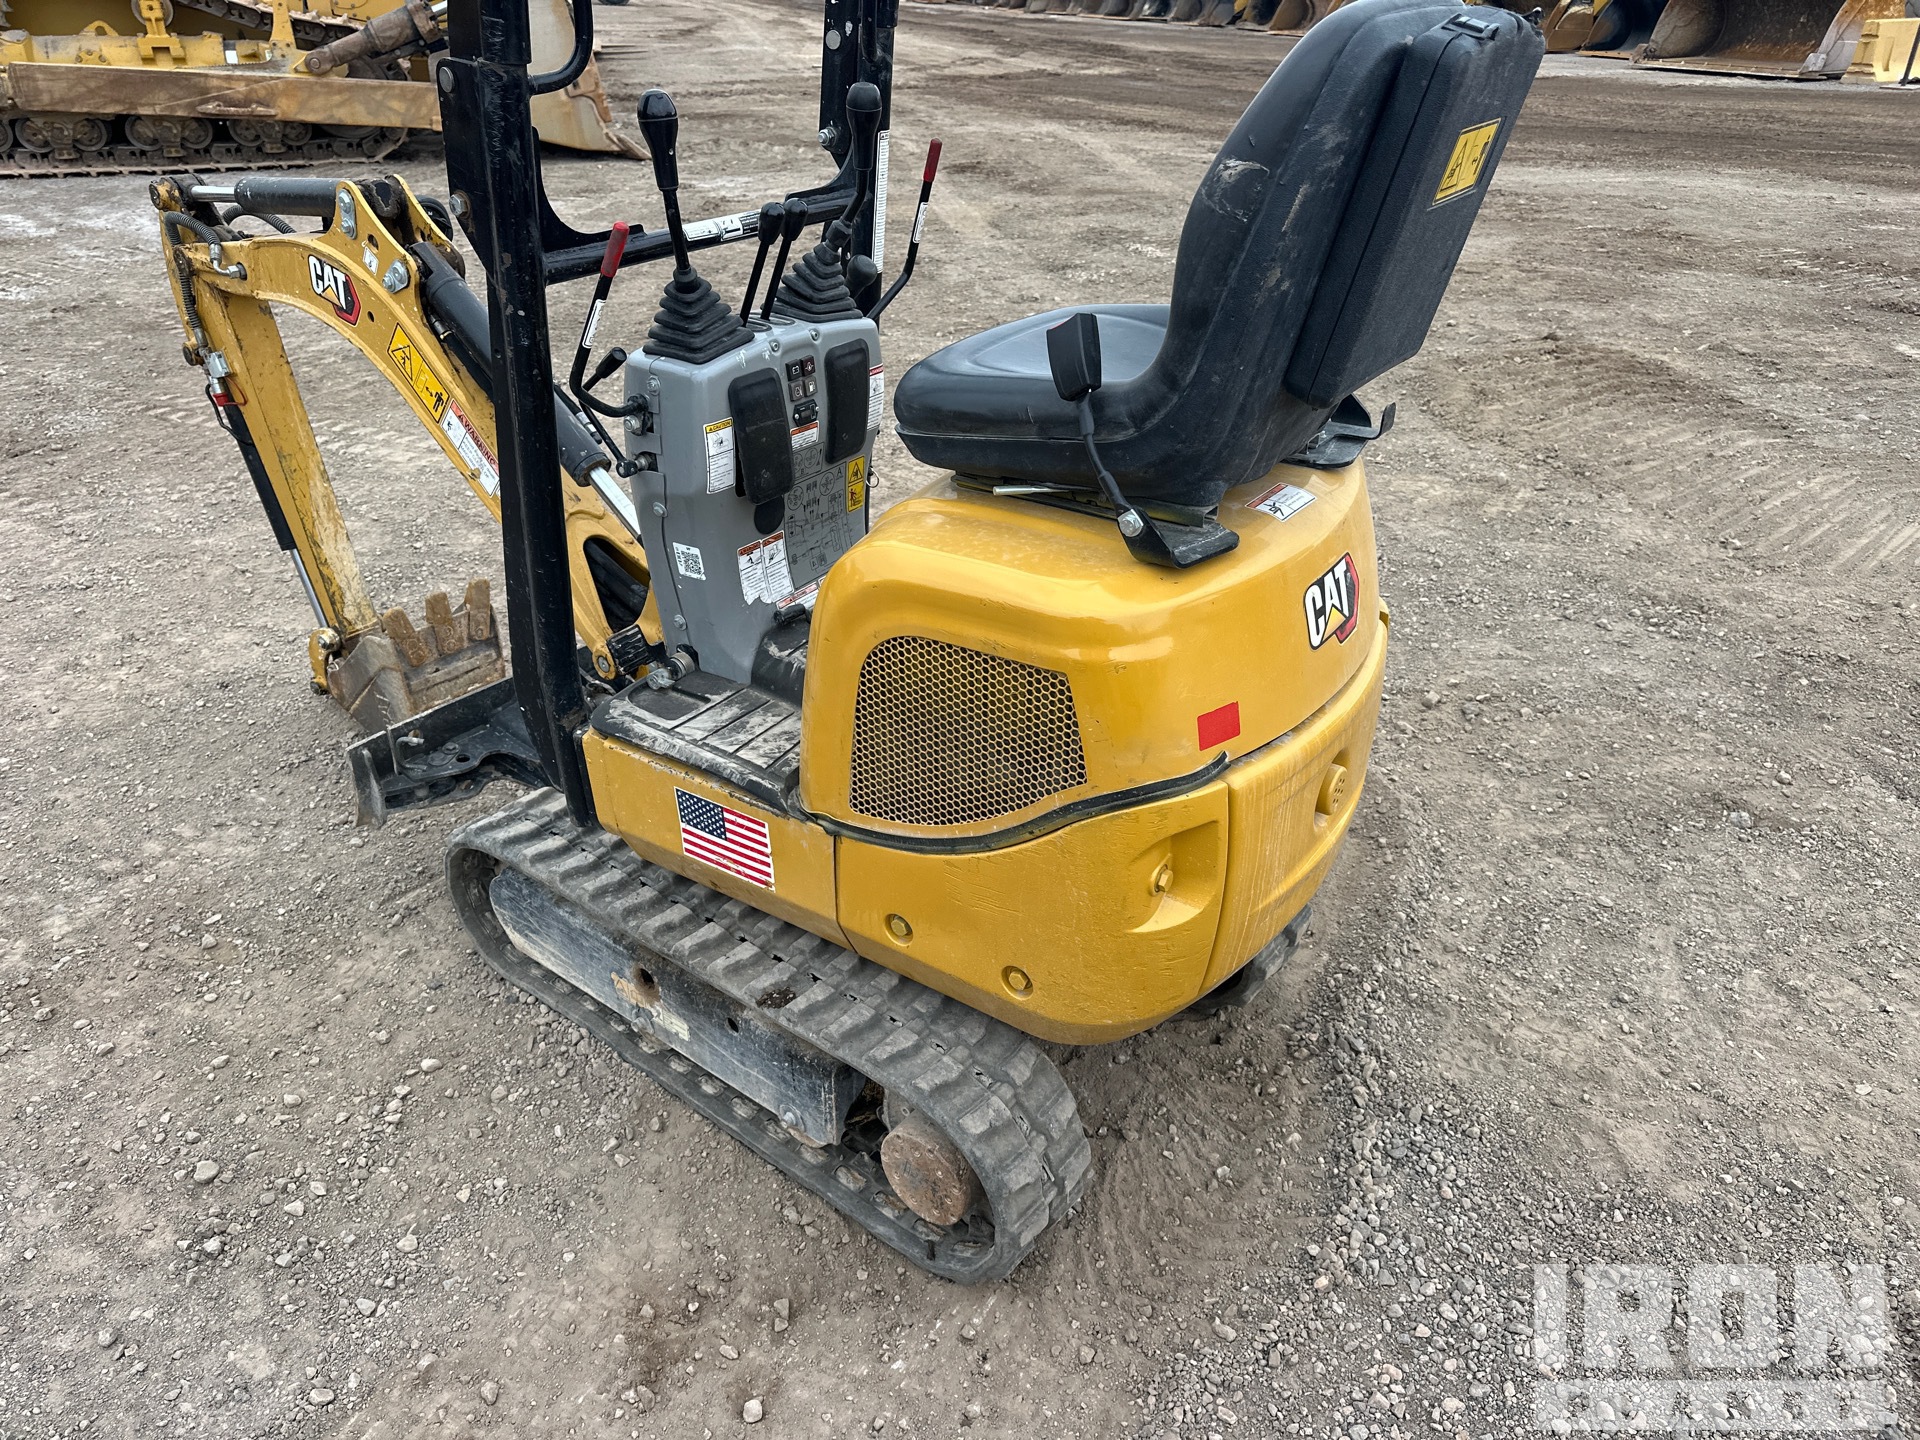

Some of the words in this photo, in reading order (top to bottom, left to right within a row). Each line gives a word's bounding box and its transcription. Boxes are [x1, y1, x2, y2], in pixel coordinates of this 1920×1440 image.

[308, 254, 347, 310] CAT
[464, 419, 496, 466] WARNING
[713, 420, 731, 431] CAUTION
[1304, 558, 1349, 647] CAT
